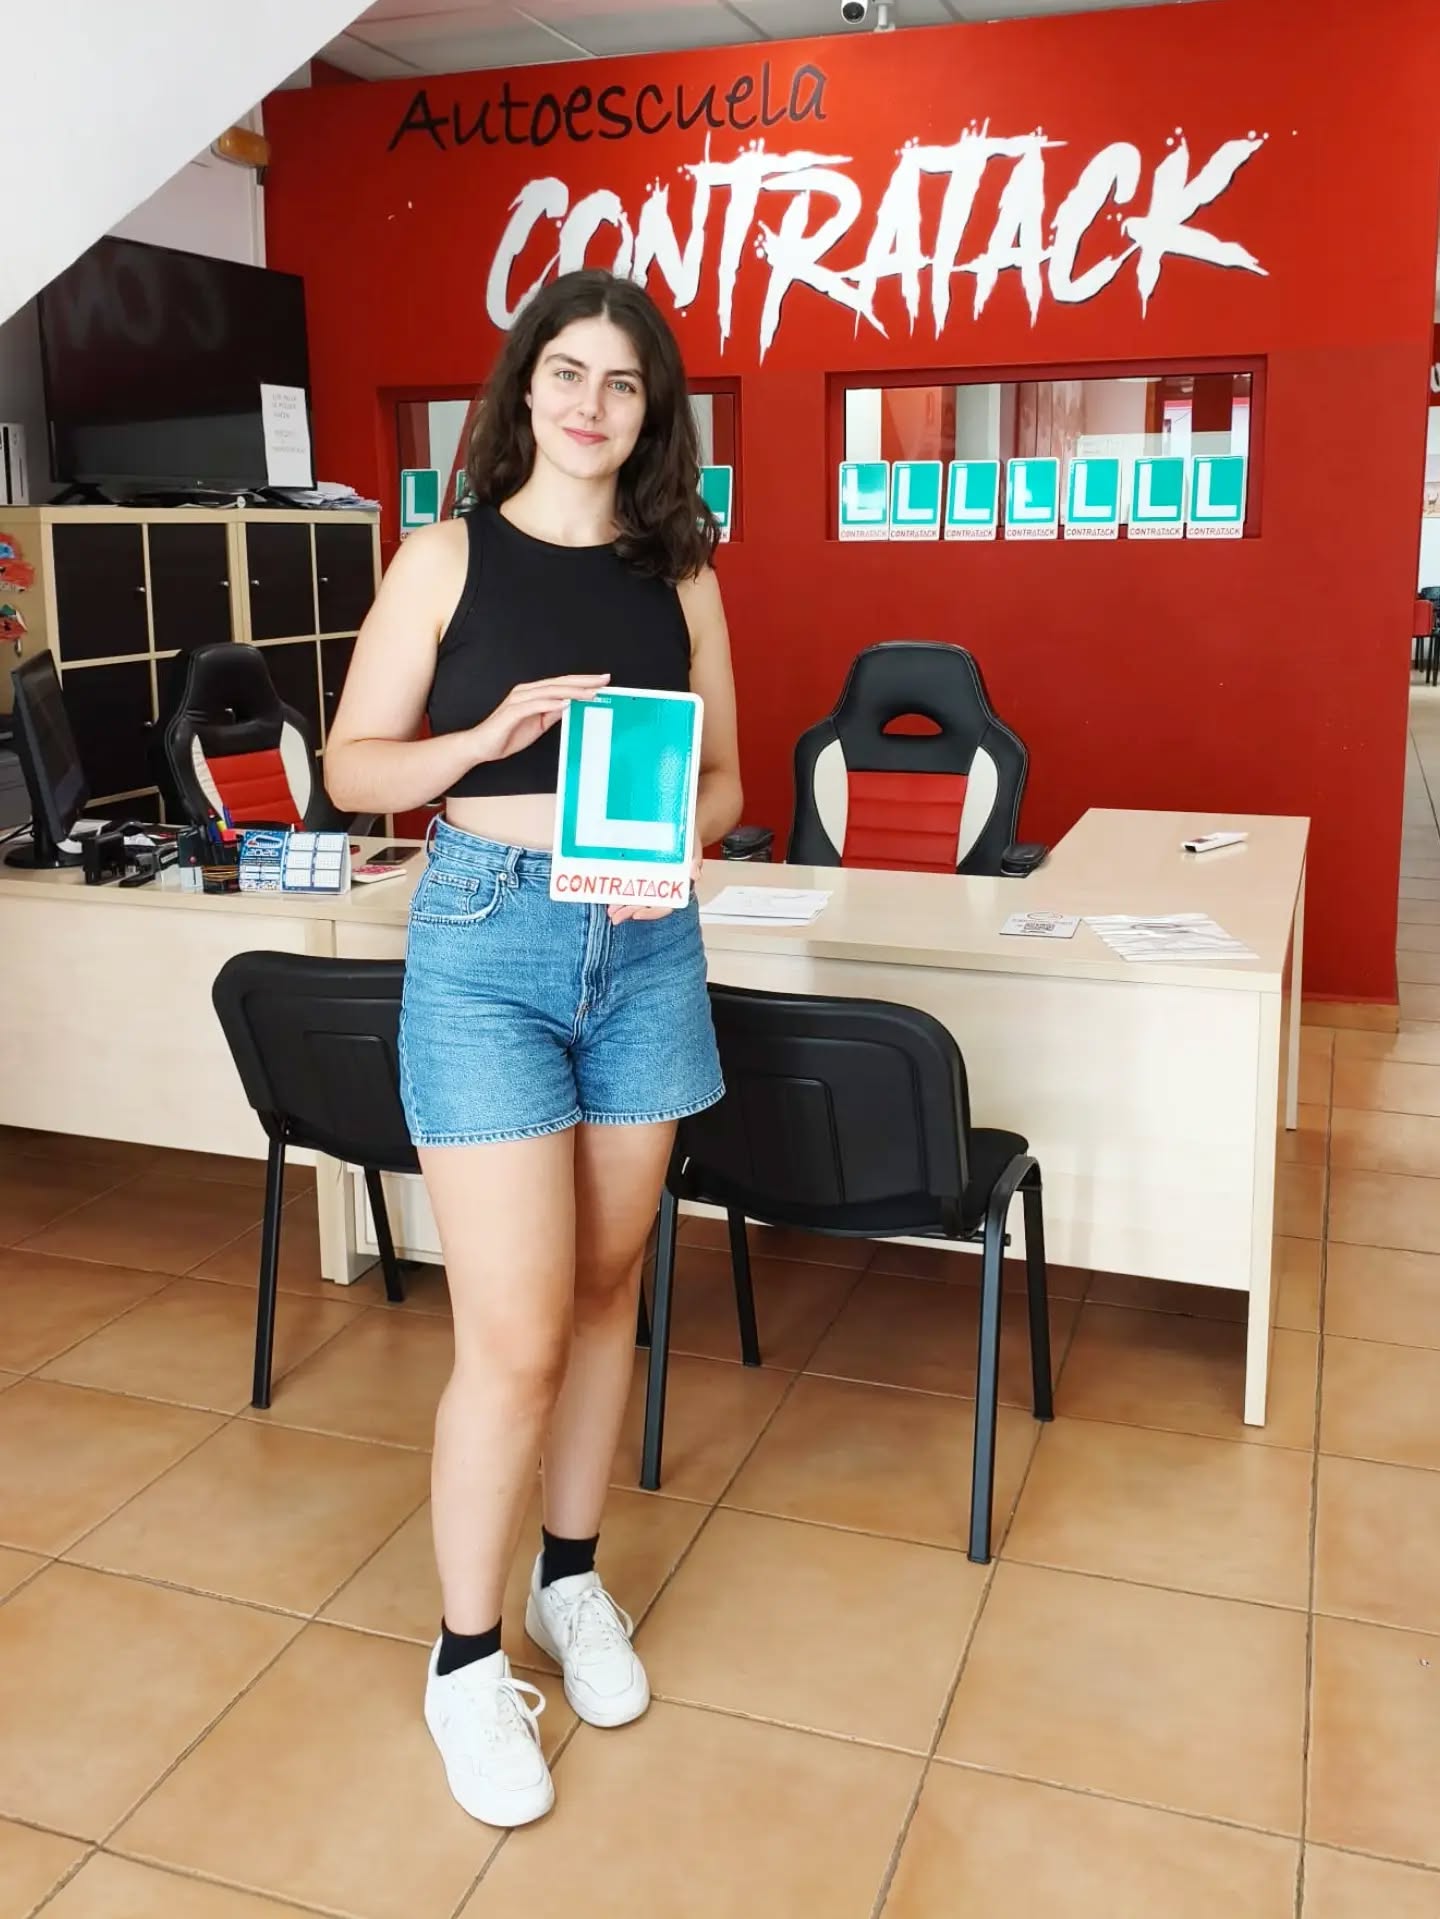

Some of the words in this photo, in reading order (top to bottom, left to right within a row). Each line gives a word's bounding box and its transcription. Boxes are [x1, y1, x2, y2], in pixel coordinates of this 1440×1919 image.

[387, 60, 829, 152] Autoescuela
[486, 118, 1270, 366] CONTRATACK
[406, 476, 435, 524] L
[846, 468, 883, 521] L
[896, 467, 934, 520] L
[953, 467, 991, 520] L
[1013, 465, 1052, 519] L
[1073, 463, 1113, 518] L
[1137, 463, 1178, 518] L
[1195, 462, 1238, 517] L
[575, 706, 675, 851] L
[555, 873, 685, 900] CONTRATACK
